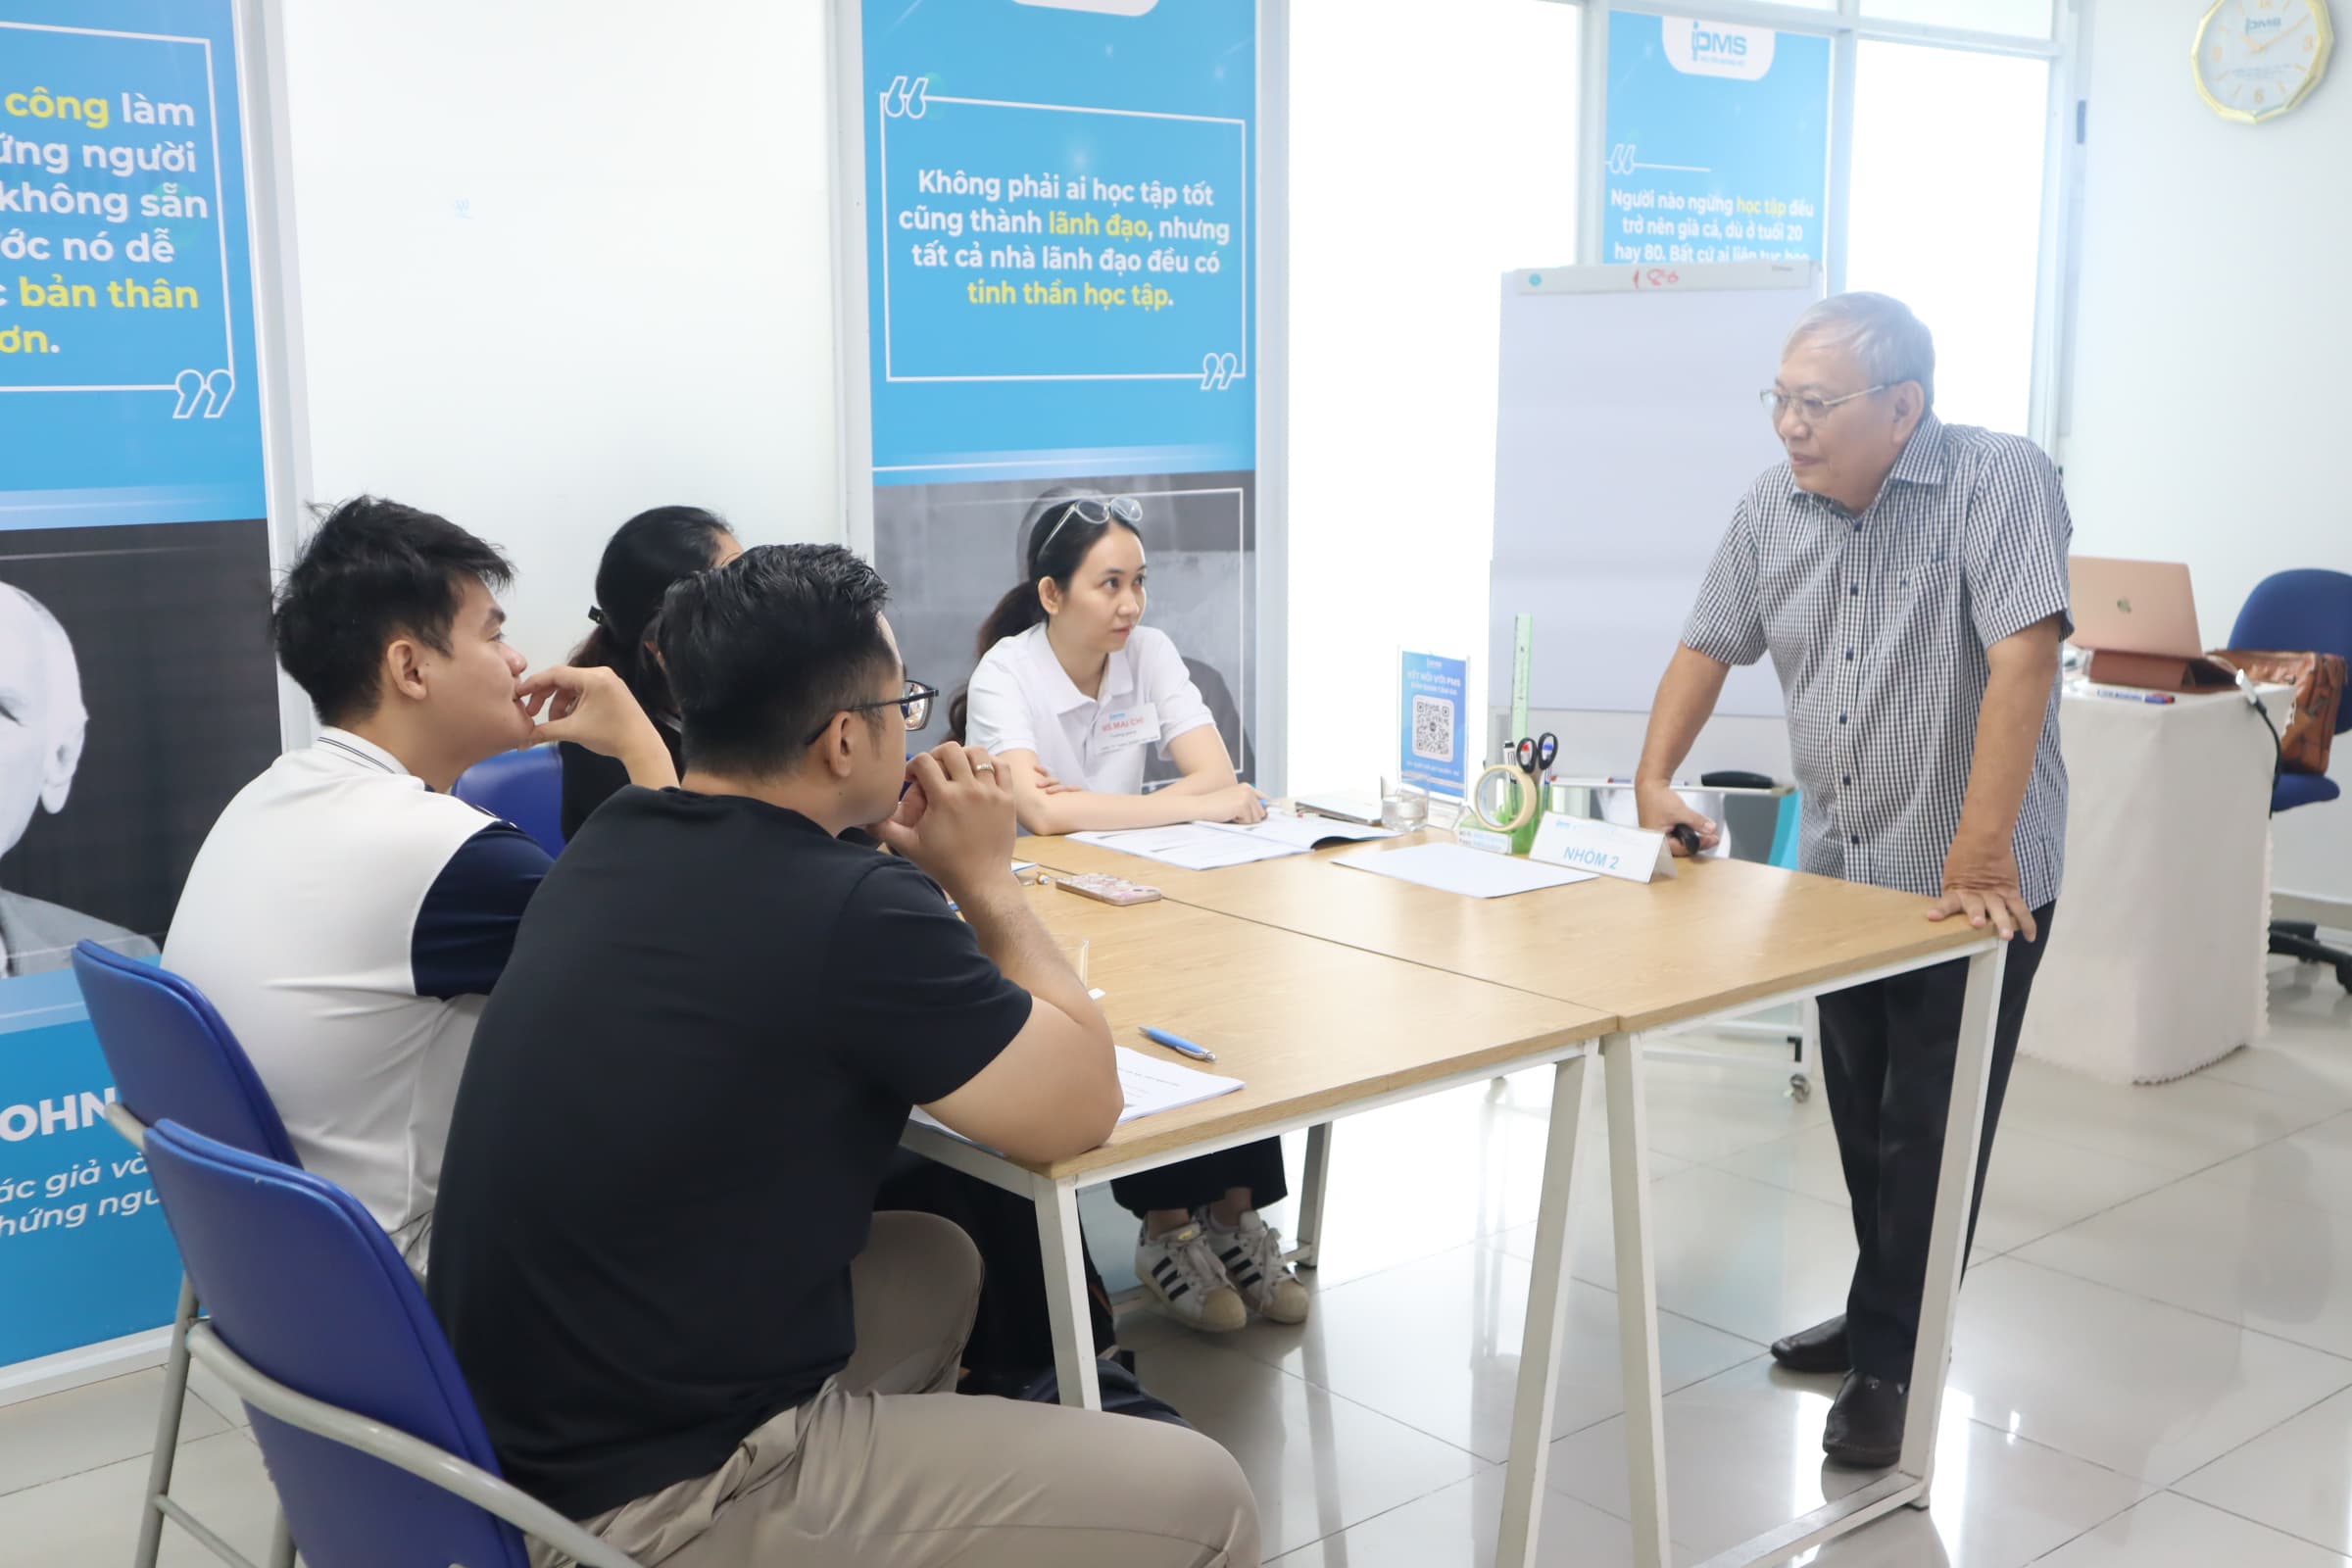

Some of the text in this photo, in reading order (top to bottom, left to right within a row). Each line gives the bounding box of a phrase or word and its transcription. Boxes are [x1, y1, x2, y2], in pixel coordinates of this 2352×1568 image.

[5, 85, 195, 128] công làm
[83, 140, 196, 177] người
[0, 179, 209, 223] không sẵn
[918, 169, 1214, 208] Không phải ai học tập tốt
[1611, 188, 1655, 212] Người
[1658, 192, 1686, 211] nào
[1689, 193, 1734, 218] ngừng
[1737, 195, 1761, 216] học
[899, 205, 1230, 245] cũng thành lãnh đạo, nhưng
[1623, 217, 1644, 234] trở
[1647, 219, 1675, 235] nên
[1725, 221, 1743, 238] dù
[1758, 222, 1785, 241] tuổi
[1787, 225, 1803, 241] 20
[63, 228, 114, 263] nó
[125, 226, 174, 264] dễ
[911, 238, 1221, 276] tất cả nhà lãnh đạo đều có
[1614, 242, 1641, 264] hay
[19, 273, 97, 308] bản
[108, 277, 199, 309] thân
[967, 278, 1174, 312] tinh thần học tập.
[1609, 855, 1620, 870] 2
[0, 1087, 116, 1142] OHN
[45, 1158, 101, 1199] giả
